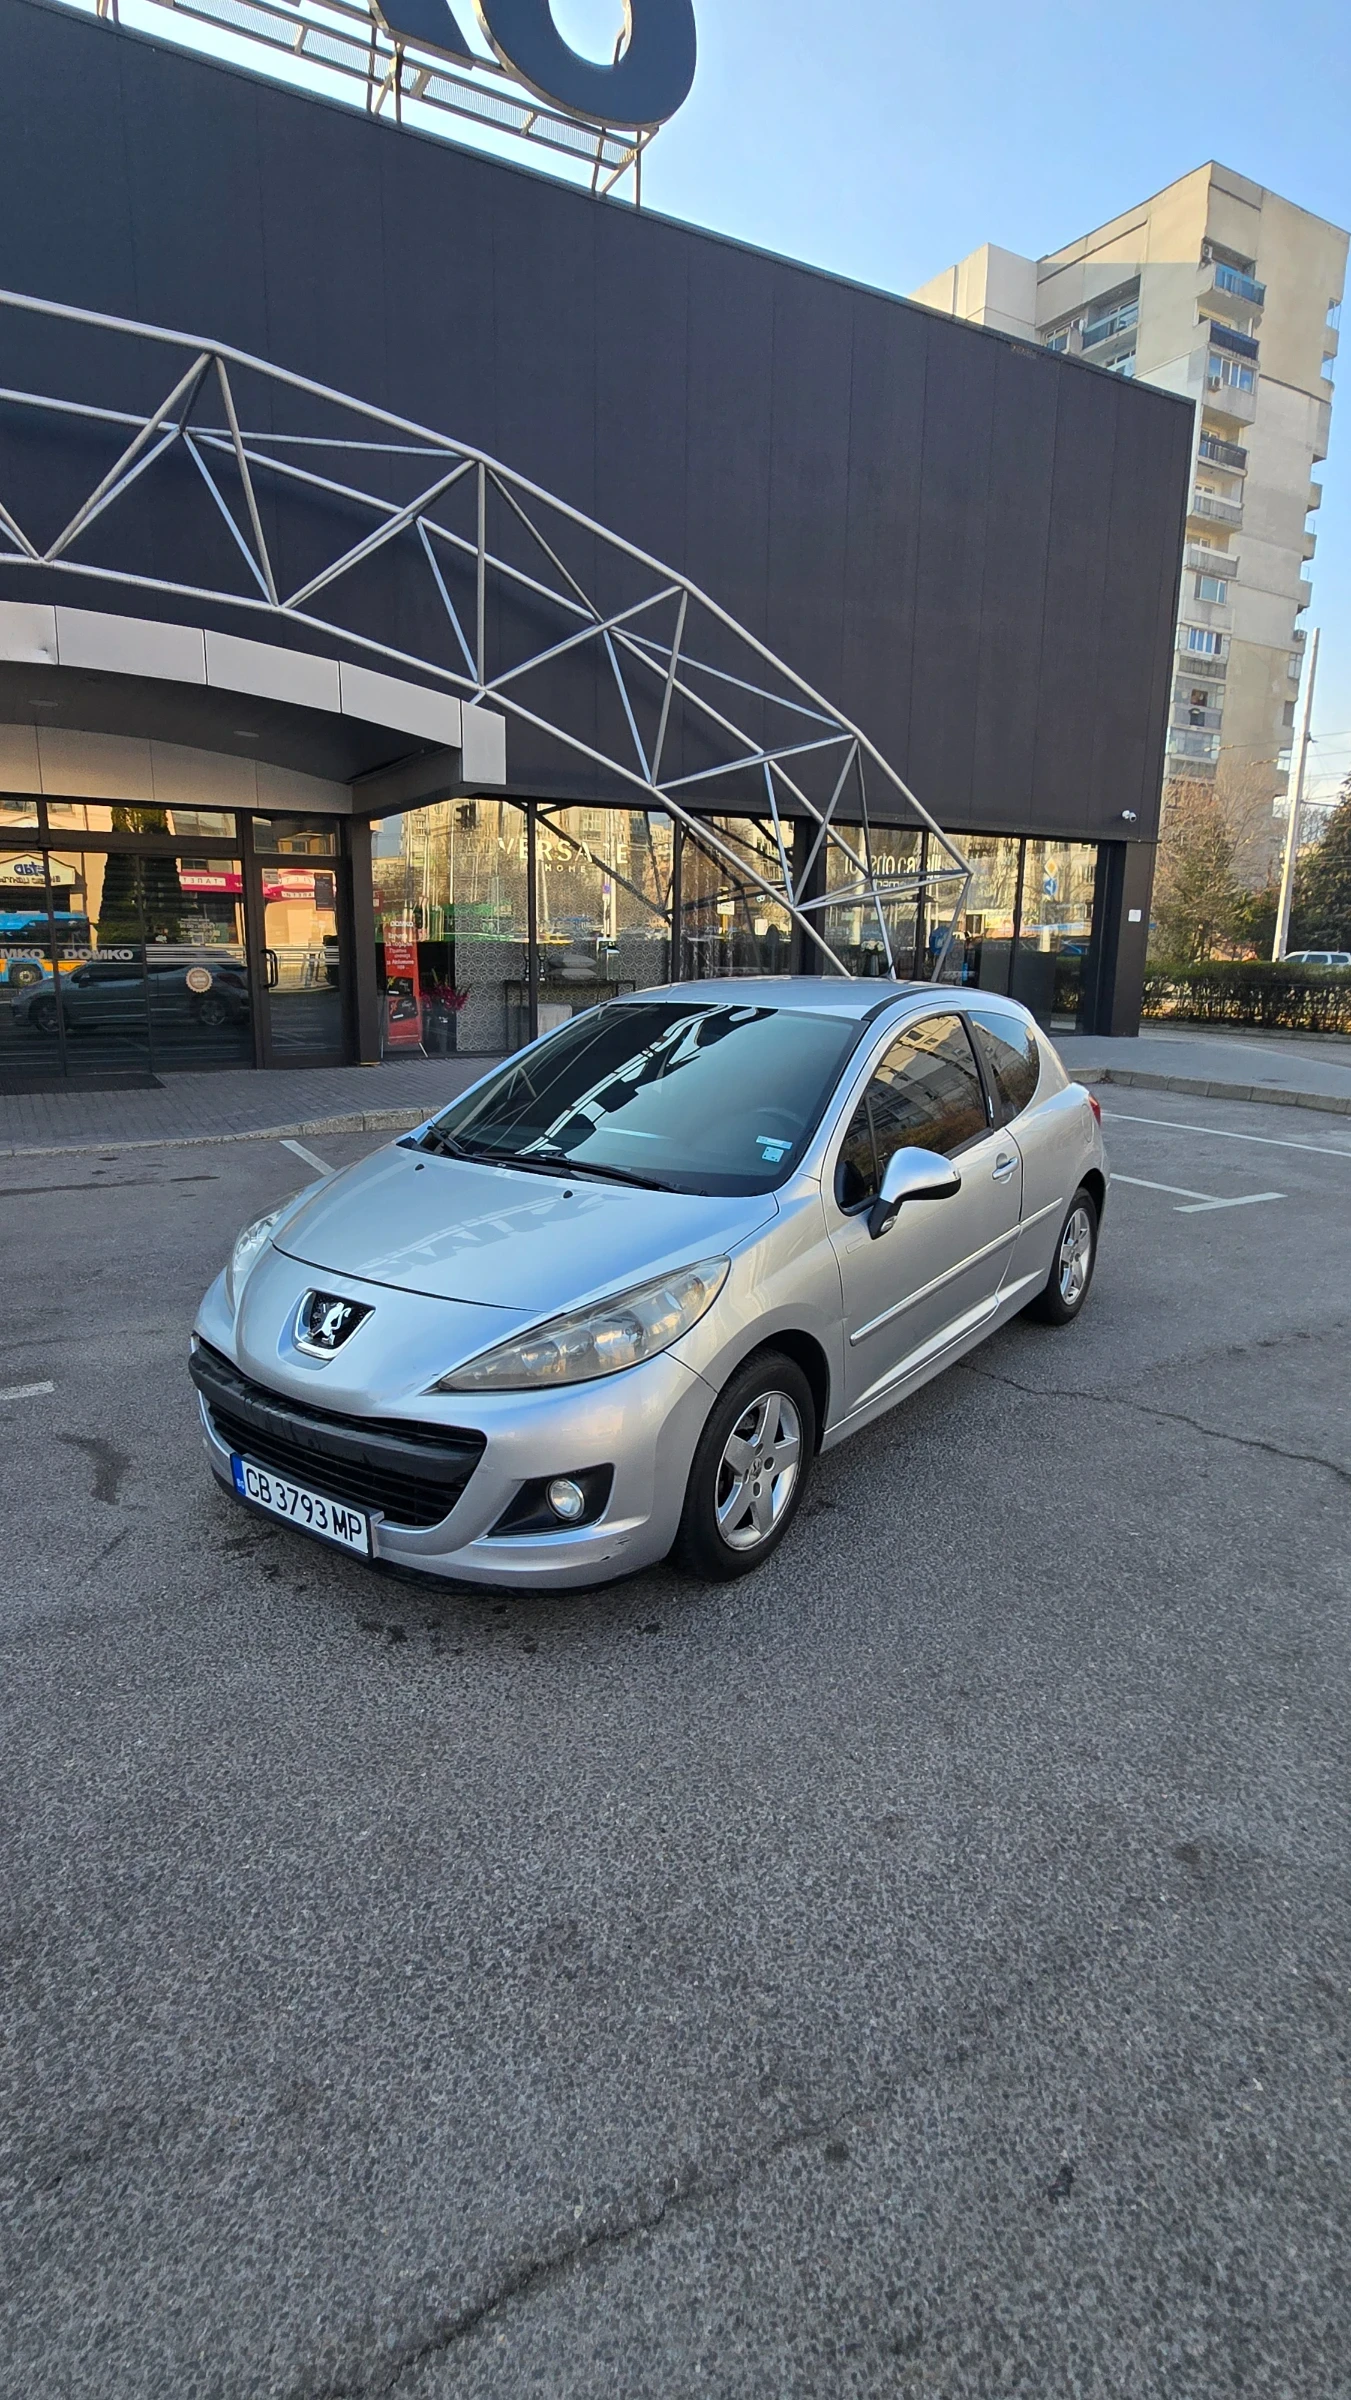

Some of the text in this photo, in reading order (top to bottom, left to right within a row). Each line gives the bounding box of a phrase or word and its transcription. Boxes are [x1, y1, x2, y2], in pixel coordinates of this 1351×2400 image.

[545, 863, 586, 873] HOME
[63, 948, 134, 960] DOMKO
[246, 1467, 362, 1542] CB 3793 MP
